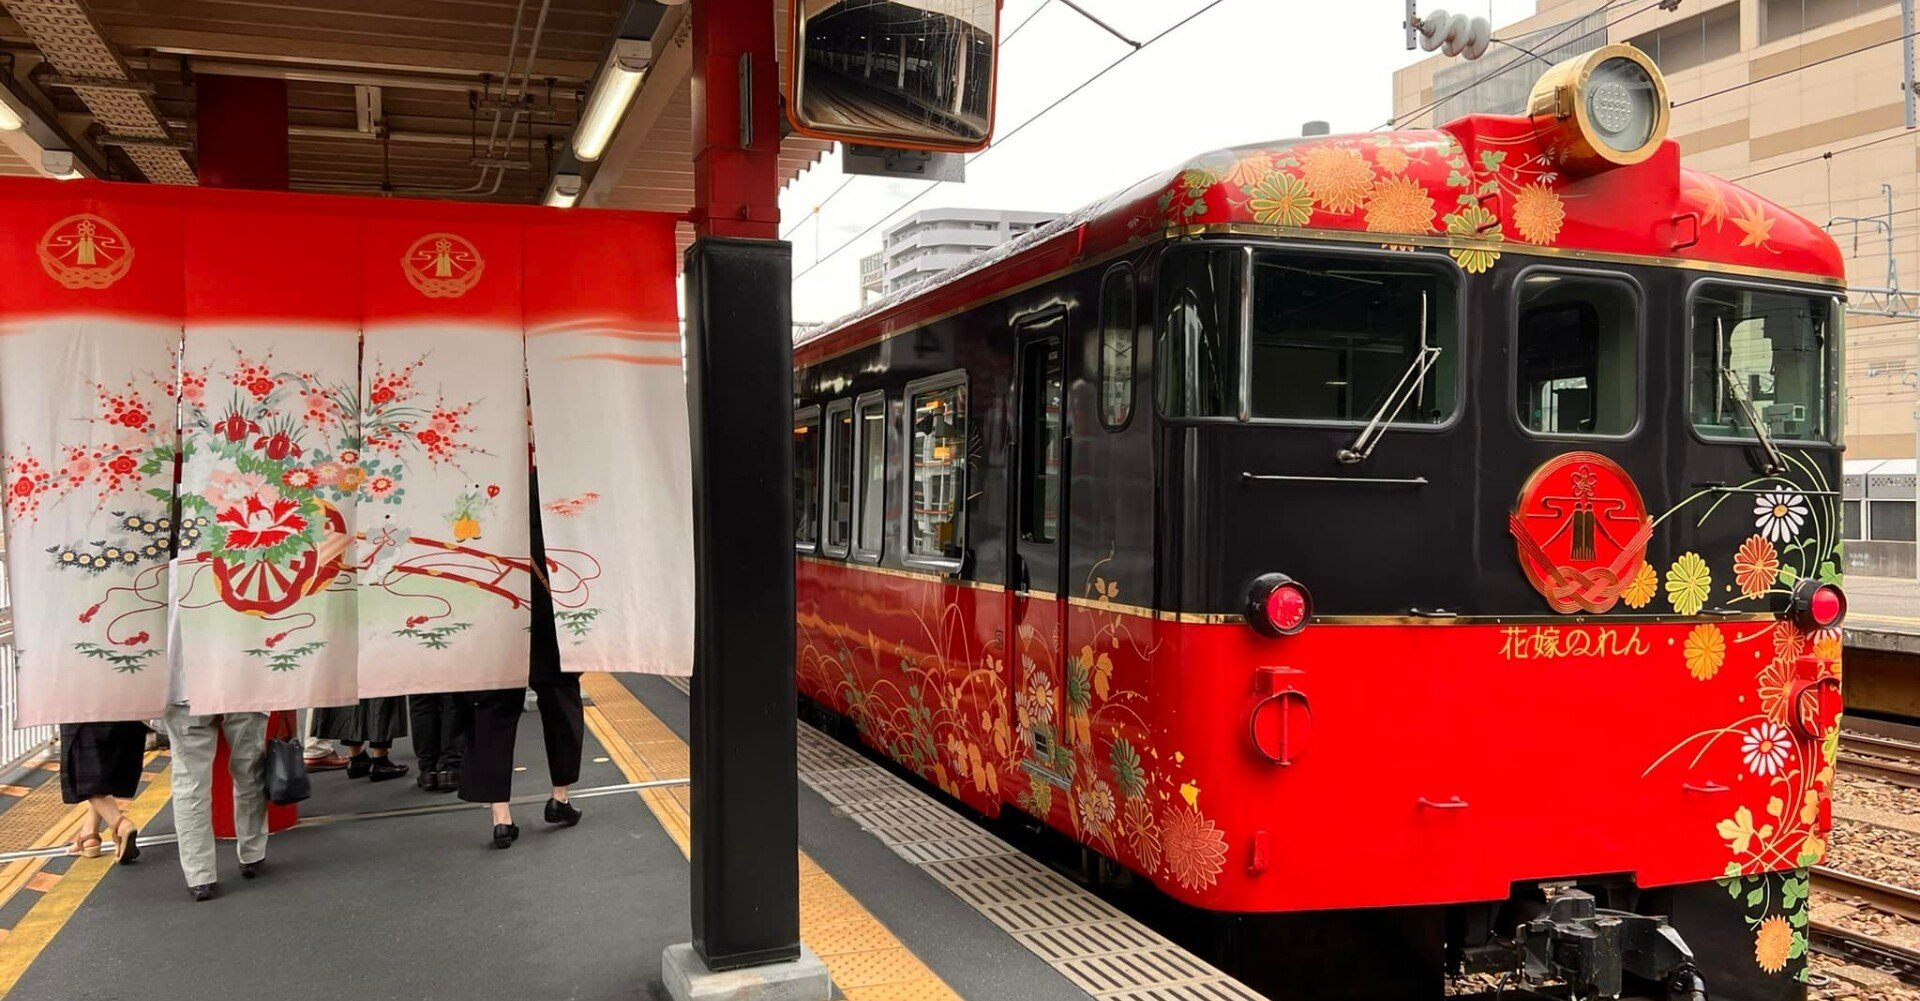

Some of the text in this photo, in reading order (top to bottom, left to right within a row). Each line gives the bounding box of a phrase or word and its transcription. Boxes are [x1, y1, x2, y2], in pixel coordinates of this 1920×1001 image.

[1498, 626, 1650, 660] 花嫁のれん
